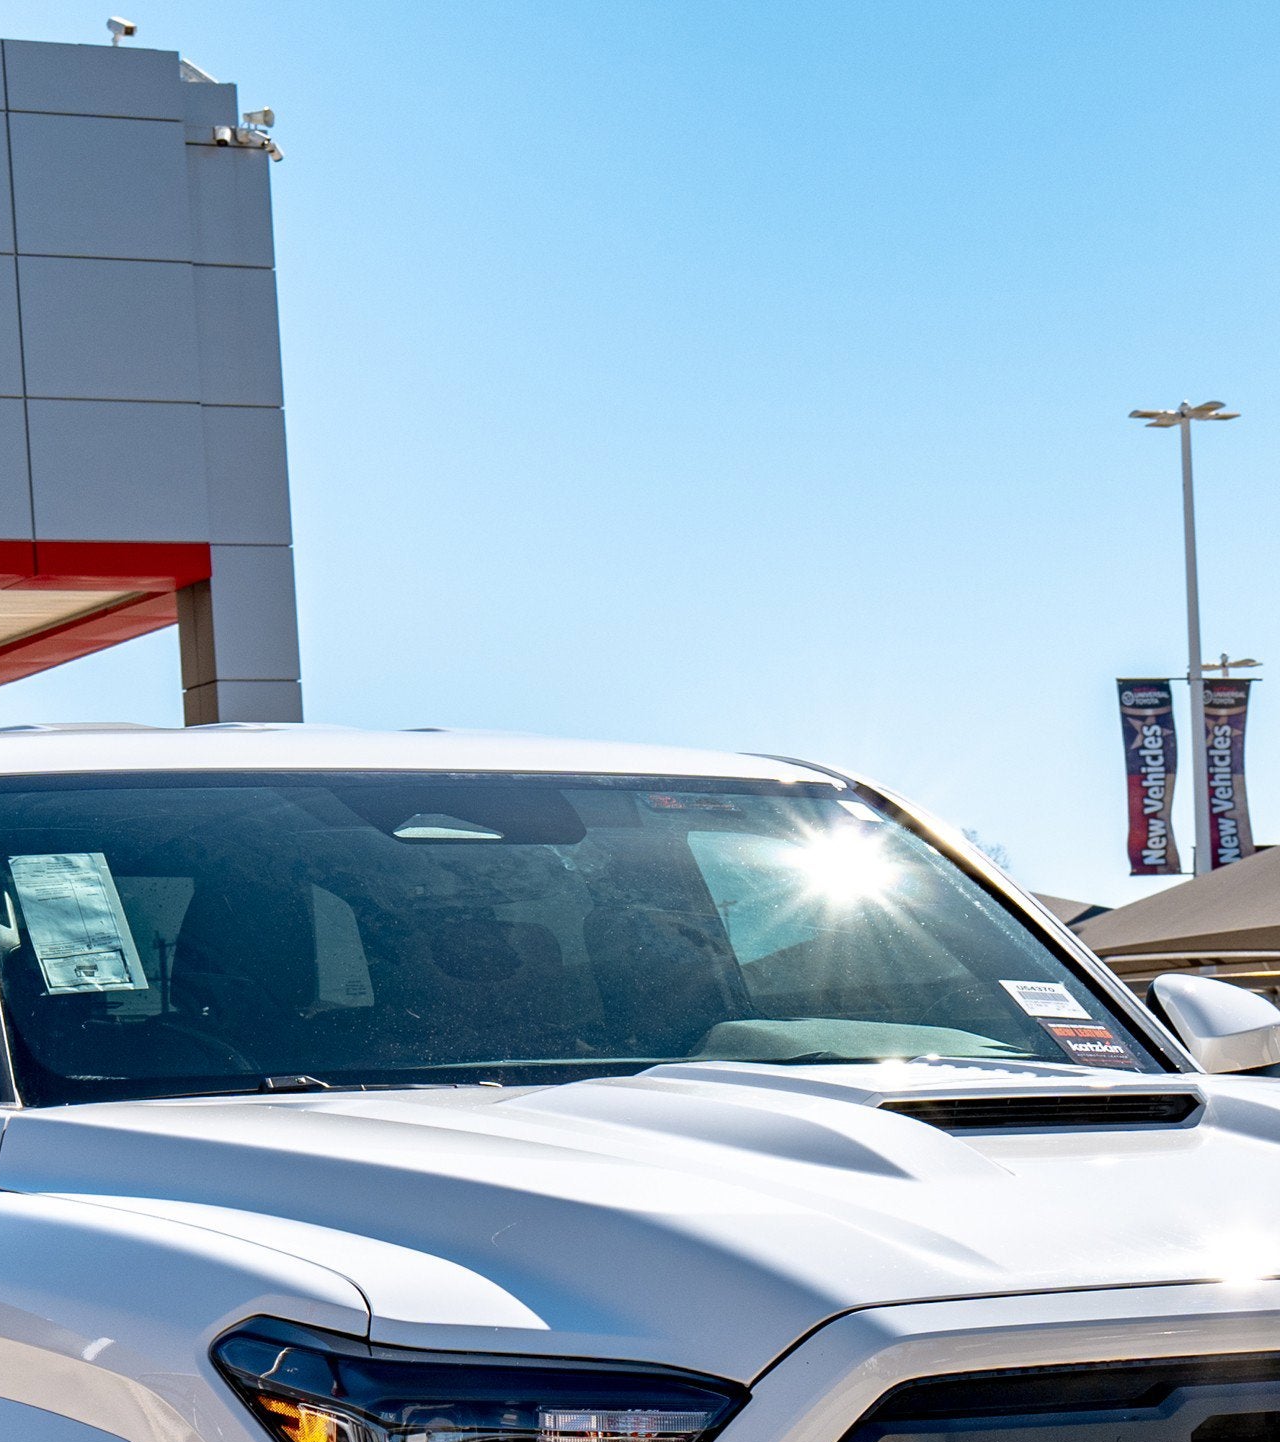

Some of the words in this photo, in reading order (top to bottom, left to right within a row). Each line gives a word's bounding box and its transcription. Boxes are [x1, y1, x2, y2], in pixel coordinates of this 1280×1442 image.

[1139, 723, 1167, 814] Vehicles
[1209, 724, 1234, 814] Vehicles
[1140, 818, 1167, 866] New
[1218, 817, 1242, 864] New
